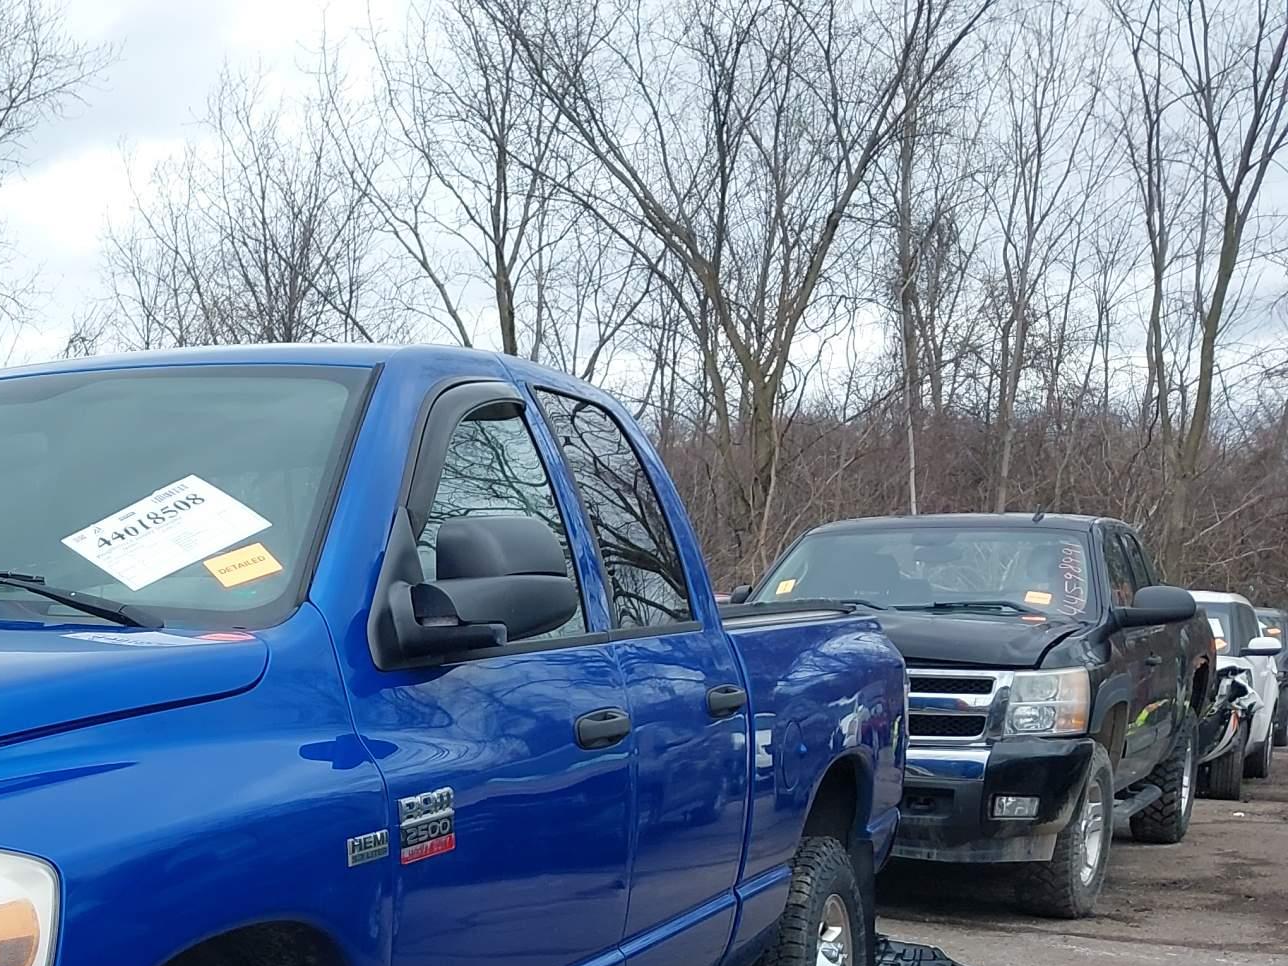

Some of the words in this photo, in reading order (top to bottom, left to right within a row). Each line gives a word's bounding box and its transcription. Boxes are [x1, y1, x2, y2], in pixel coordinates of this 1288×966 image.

[217, 554, 267, 576] DETAILED
[351, 831, 388, 854] HEMI
[406, 819, 450, 846] 2500
